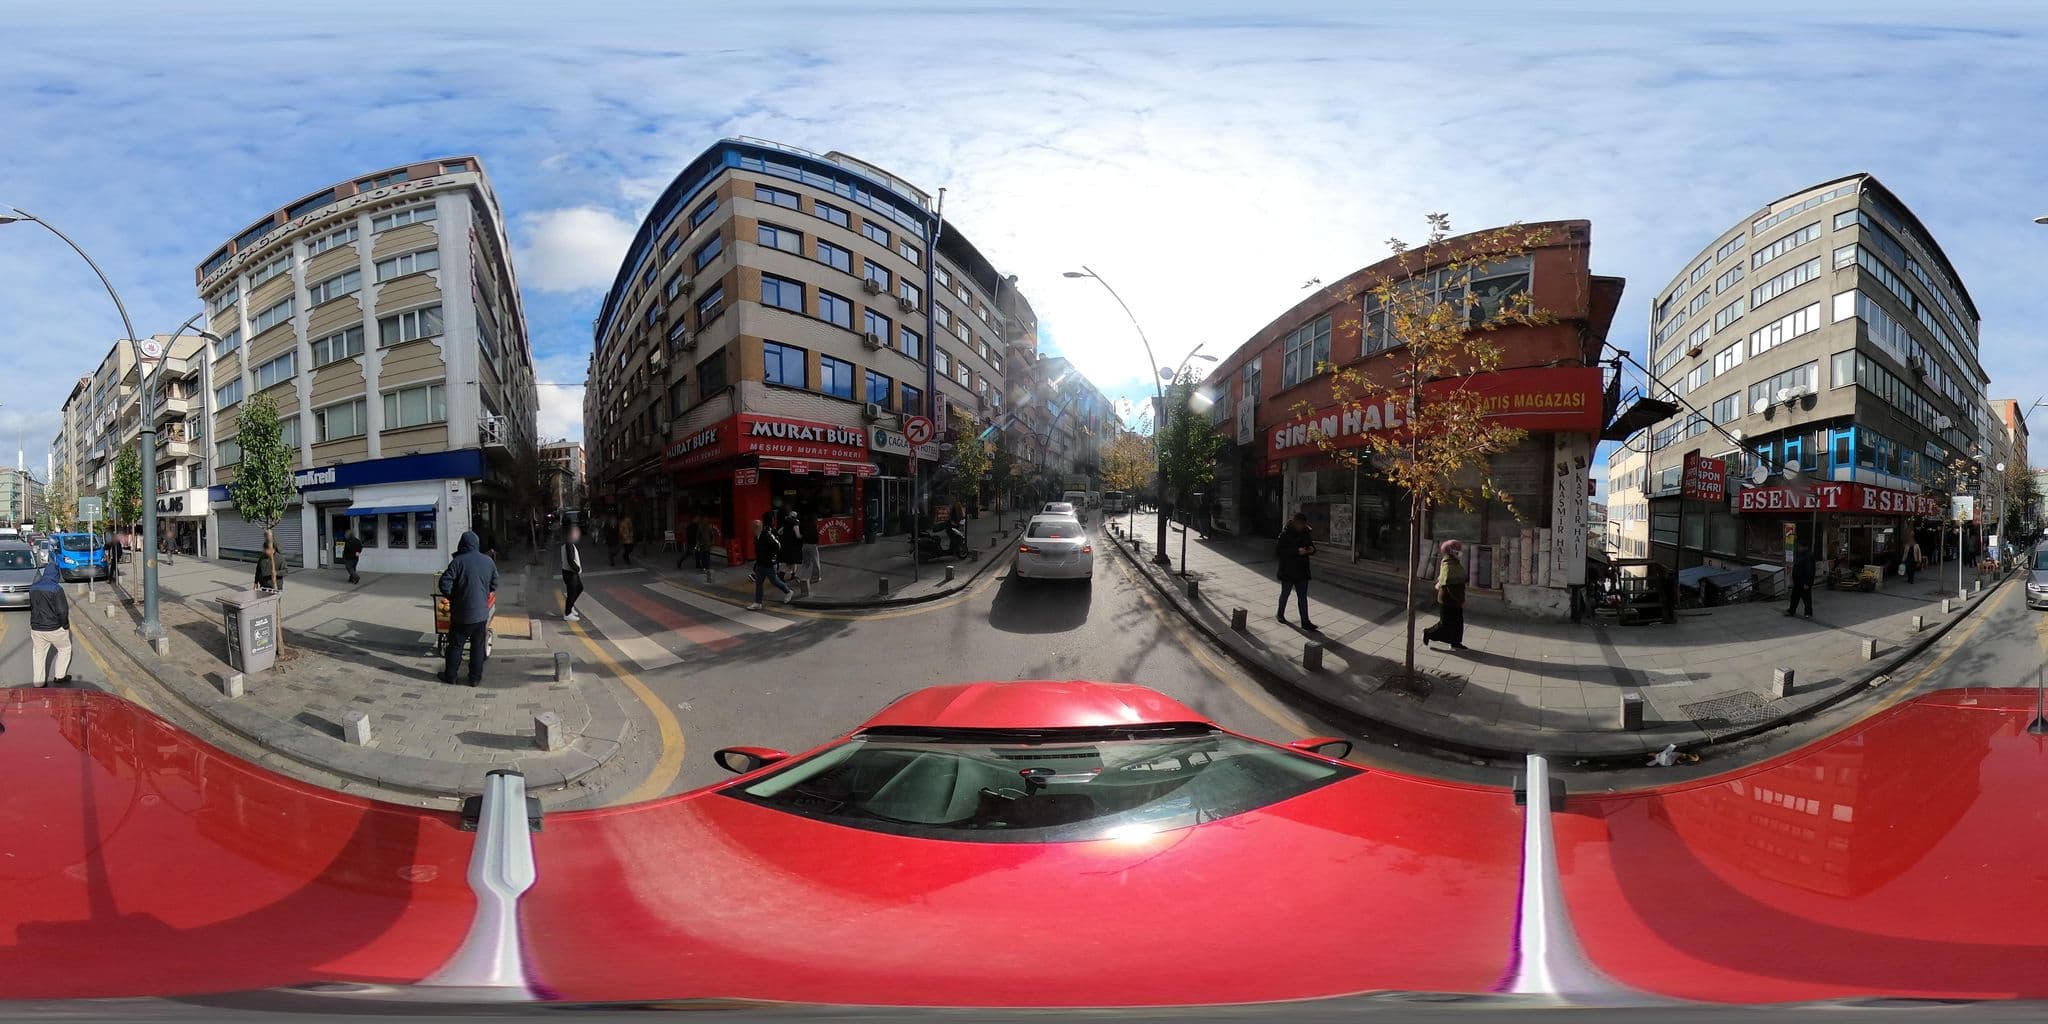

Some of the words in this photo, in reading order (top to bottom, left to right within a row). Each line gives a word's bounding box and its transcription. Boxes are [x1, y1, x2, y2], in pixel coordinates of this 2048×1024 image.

[350, 178, 457, 208] HOTEL
[1514, 391, 1585, 409] MAĞAZASI
[751, 421, 824, 441] MURAT
[827, 424, 865, 447] BÜFE
[1275, 414, 1338, 450] SİNAN
[797, 446, 828, 455] MURAT
[1862, 487, 1936, 515] ESENET
